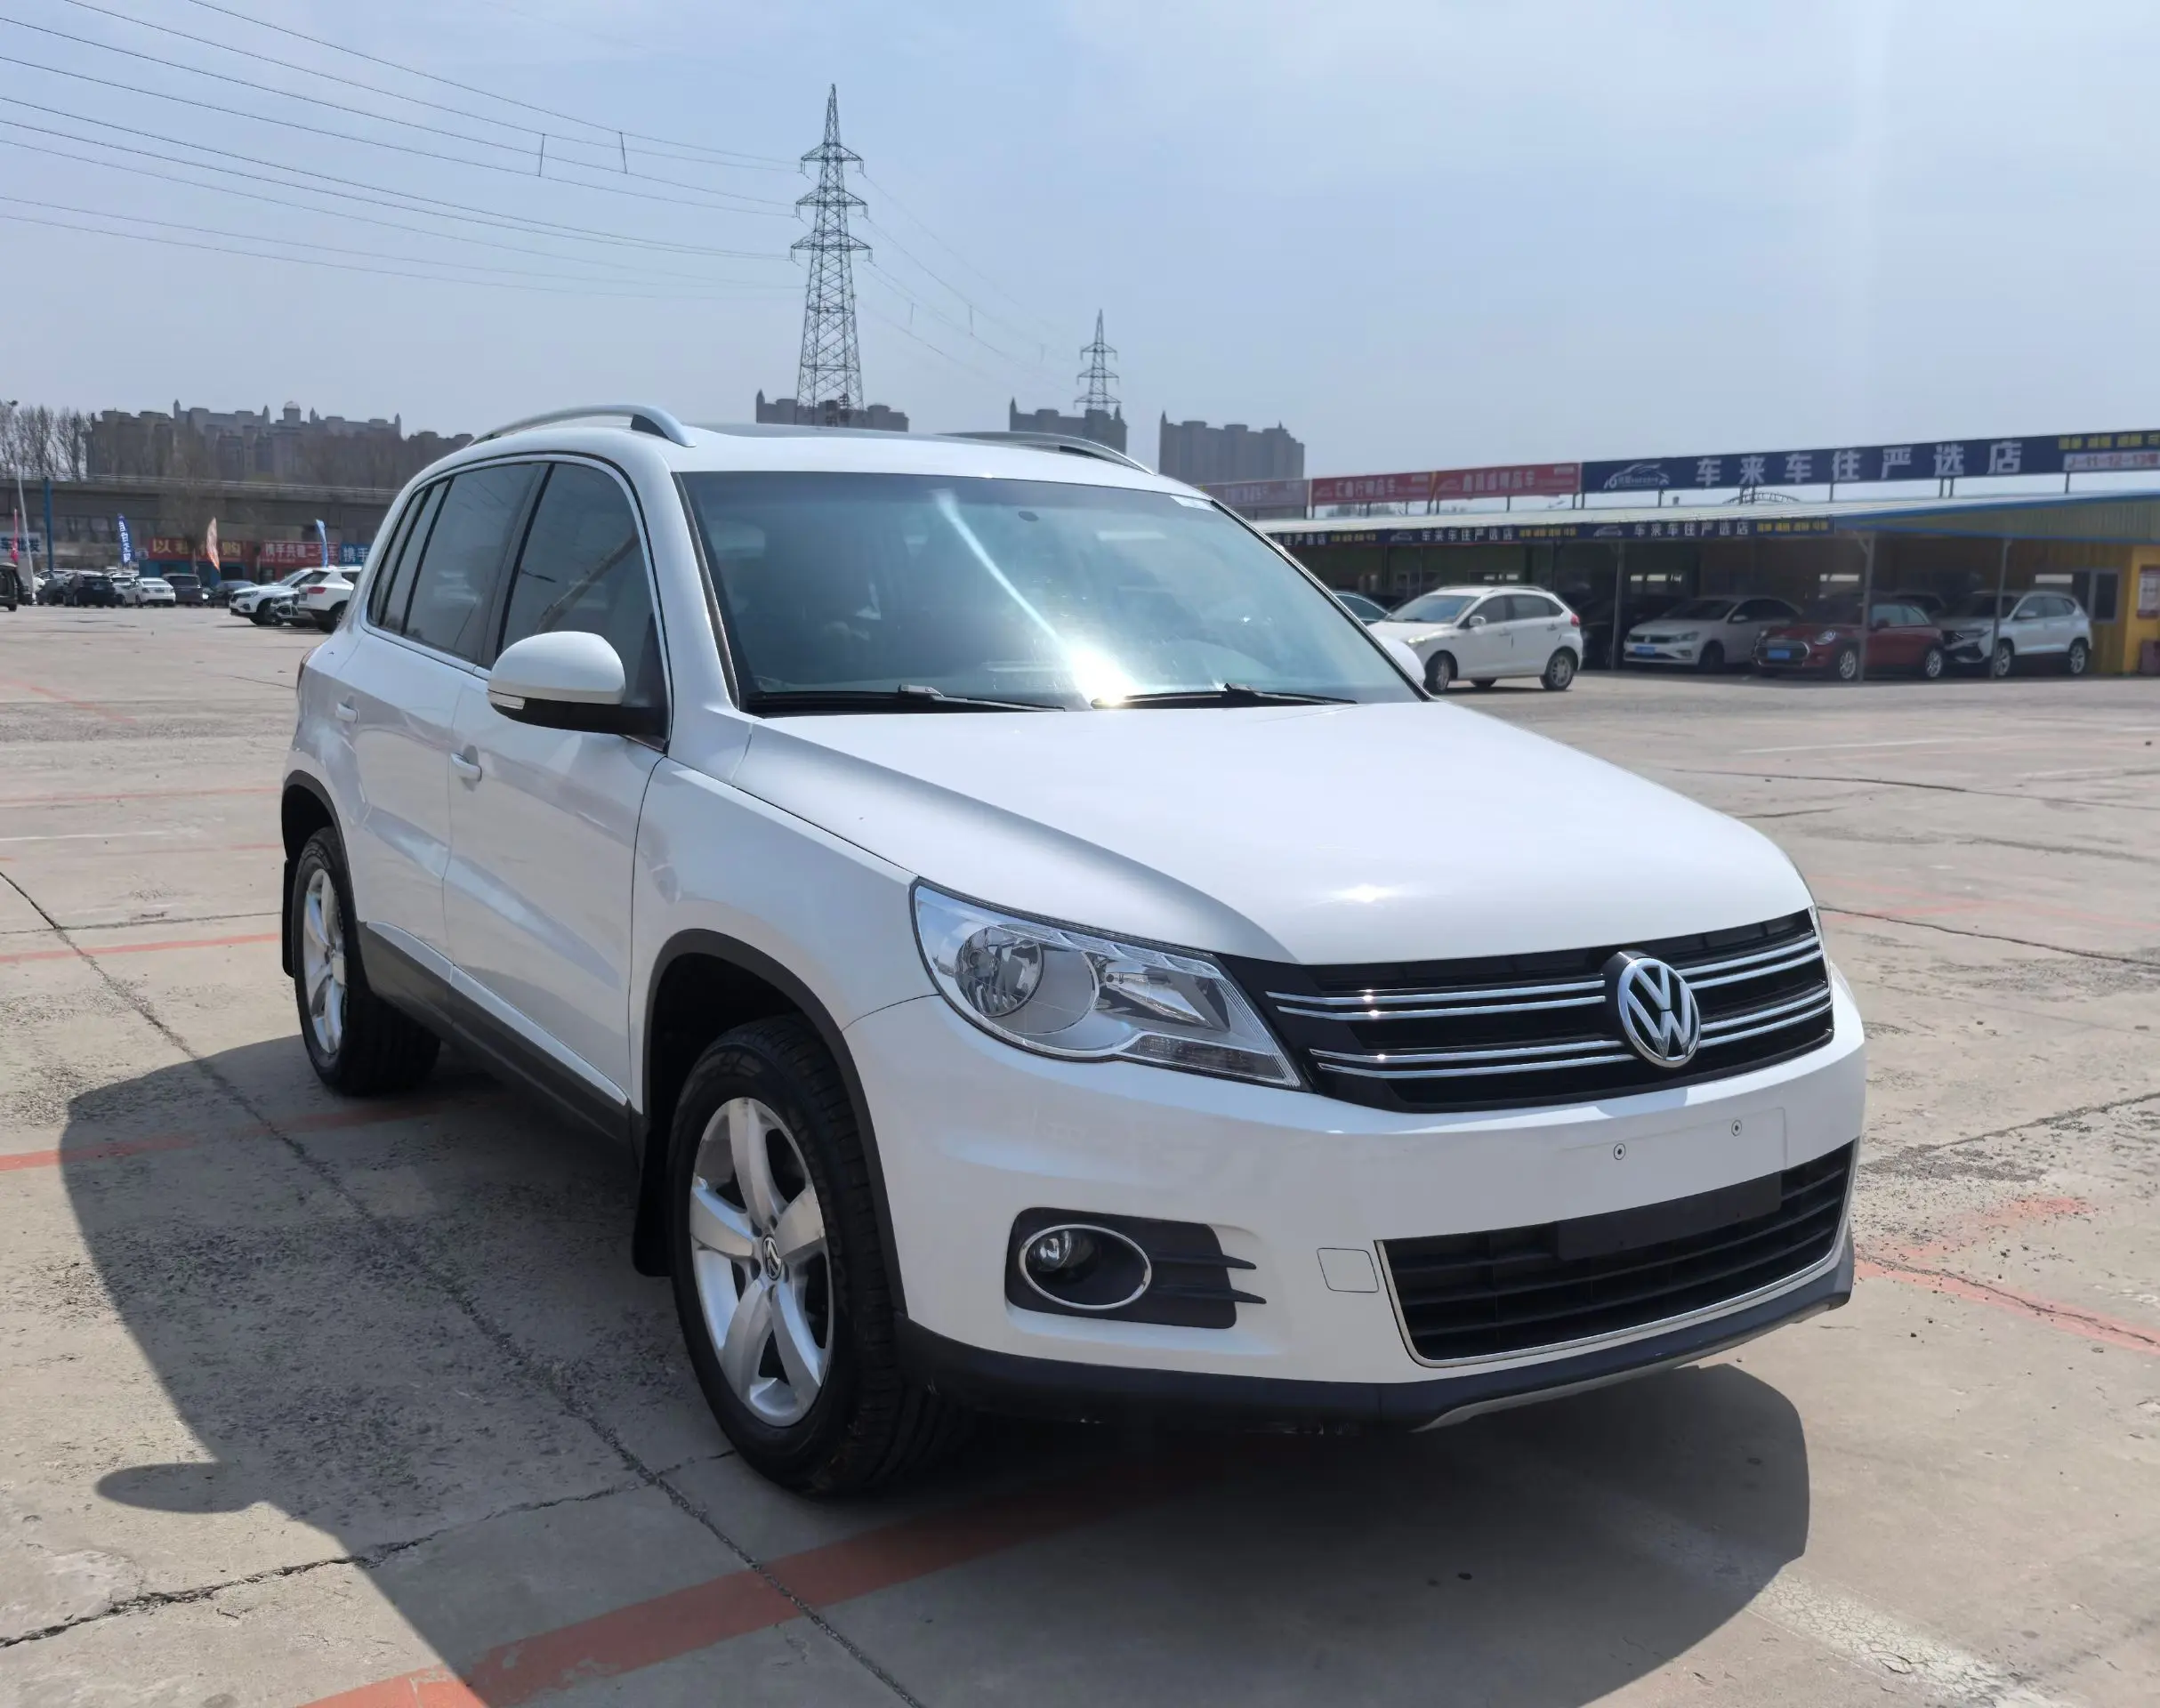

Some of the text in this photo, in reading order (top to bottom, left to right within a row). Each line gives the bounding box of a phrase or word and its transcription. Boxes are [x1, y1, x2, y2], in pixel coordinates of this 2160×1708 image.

[1695, 440, 2023, 487] 车来车往严选店
